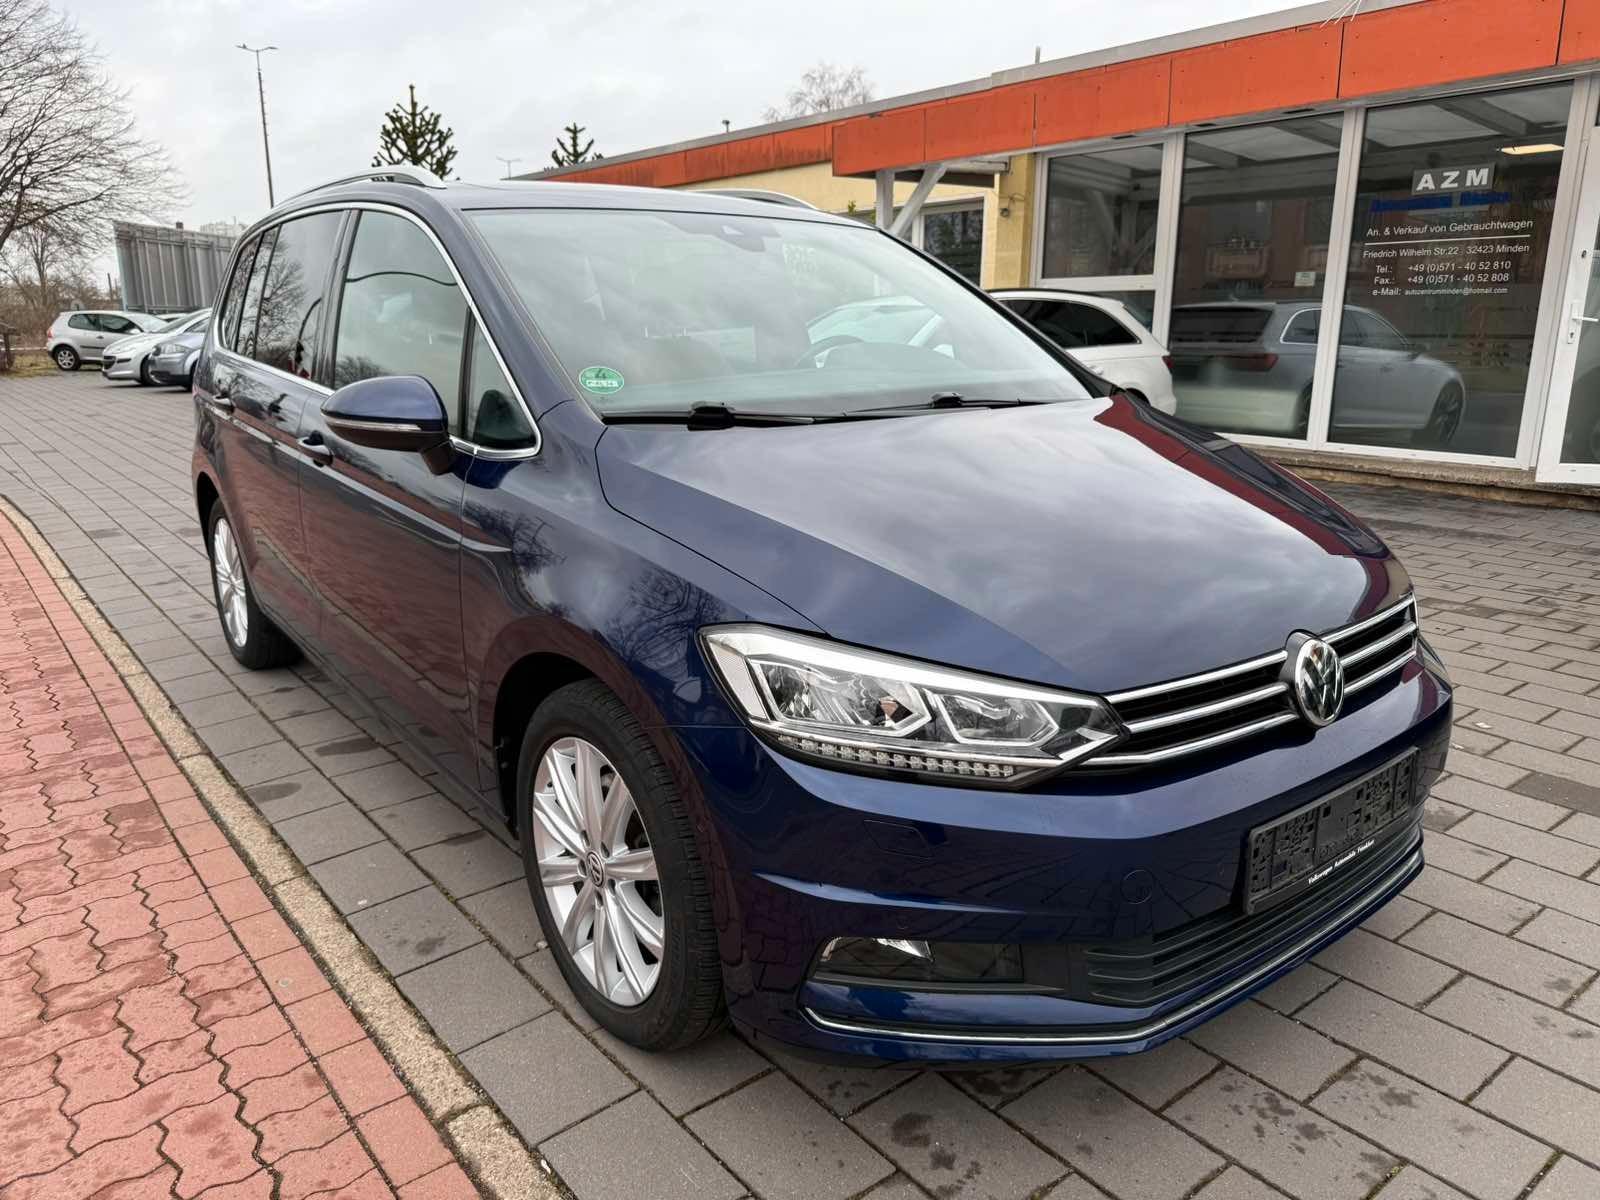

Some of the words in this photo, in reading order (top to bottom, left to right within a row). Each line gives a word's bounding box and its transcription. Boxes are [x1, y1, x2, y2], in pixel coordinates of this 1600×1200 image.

[1384, 226, 1391, 236] &
[1393, 225, 1428, 235] Verkauf
[1429, 225, 1447, 233] von
[1449, 219, 1533, 232] Gebrauchtwagen
[1362, 248, 1397, 259] Friedrich
[1399, 246, 1432, 257] Wilhelm
[1466, 244, 1494, 255] 32423
[1496, 243, 1530, 253] Minden
[1407, 263, 1425, 273] +49
[1426, 262, 1456, 273] (0)571
[1464, 261, 1477, 271] 40
[1478, 261, 1491, 270] 52
[1492, 260, 1512, 270] 810
[1407, 275, 1424, 285] +49
[1425, 274, 1455, 285] (0)571
[1462, 273, 1475, 283] 40
[1477, 273, 1490, 283] 52
[1490, 272, 1510, 282] 808
[1372, 287, 1402, 297] e-Mail:
